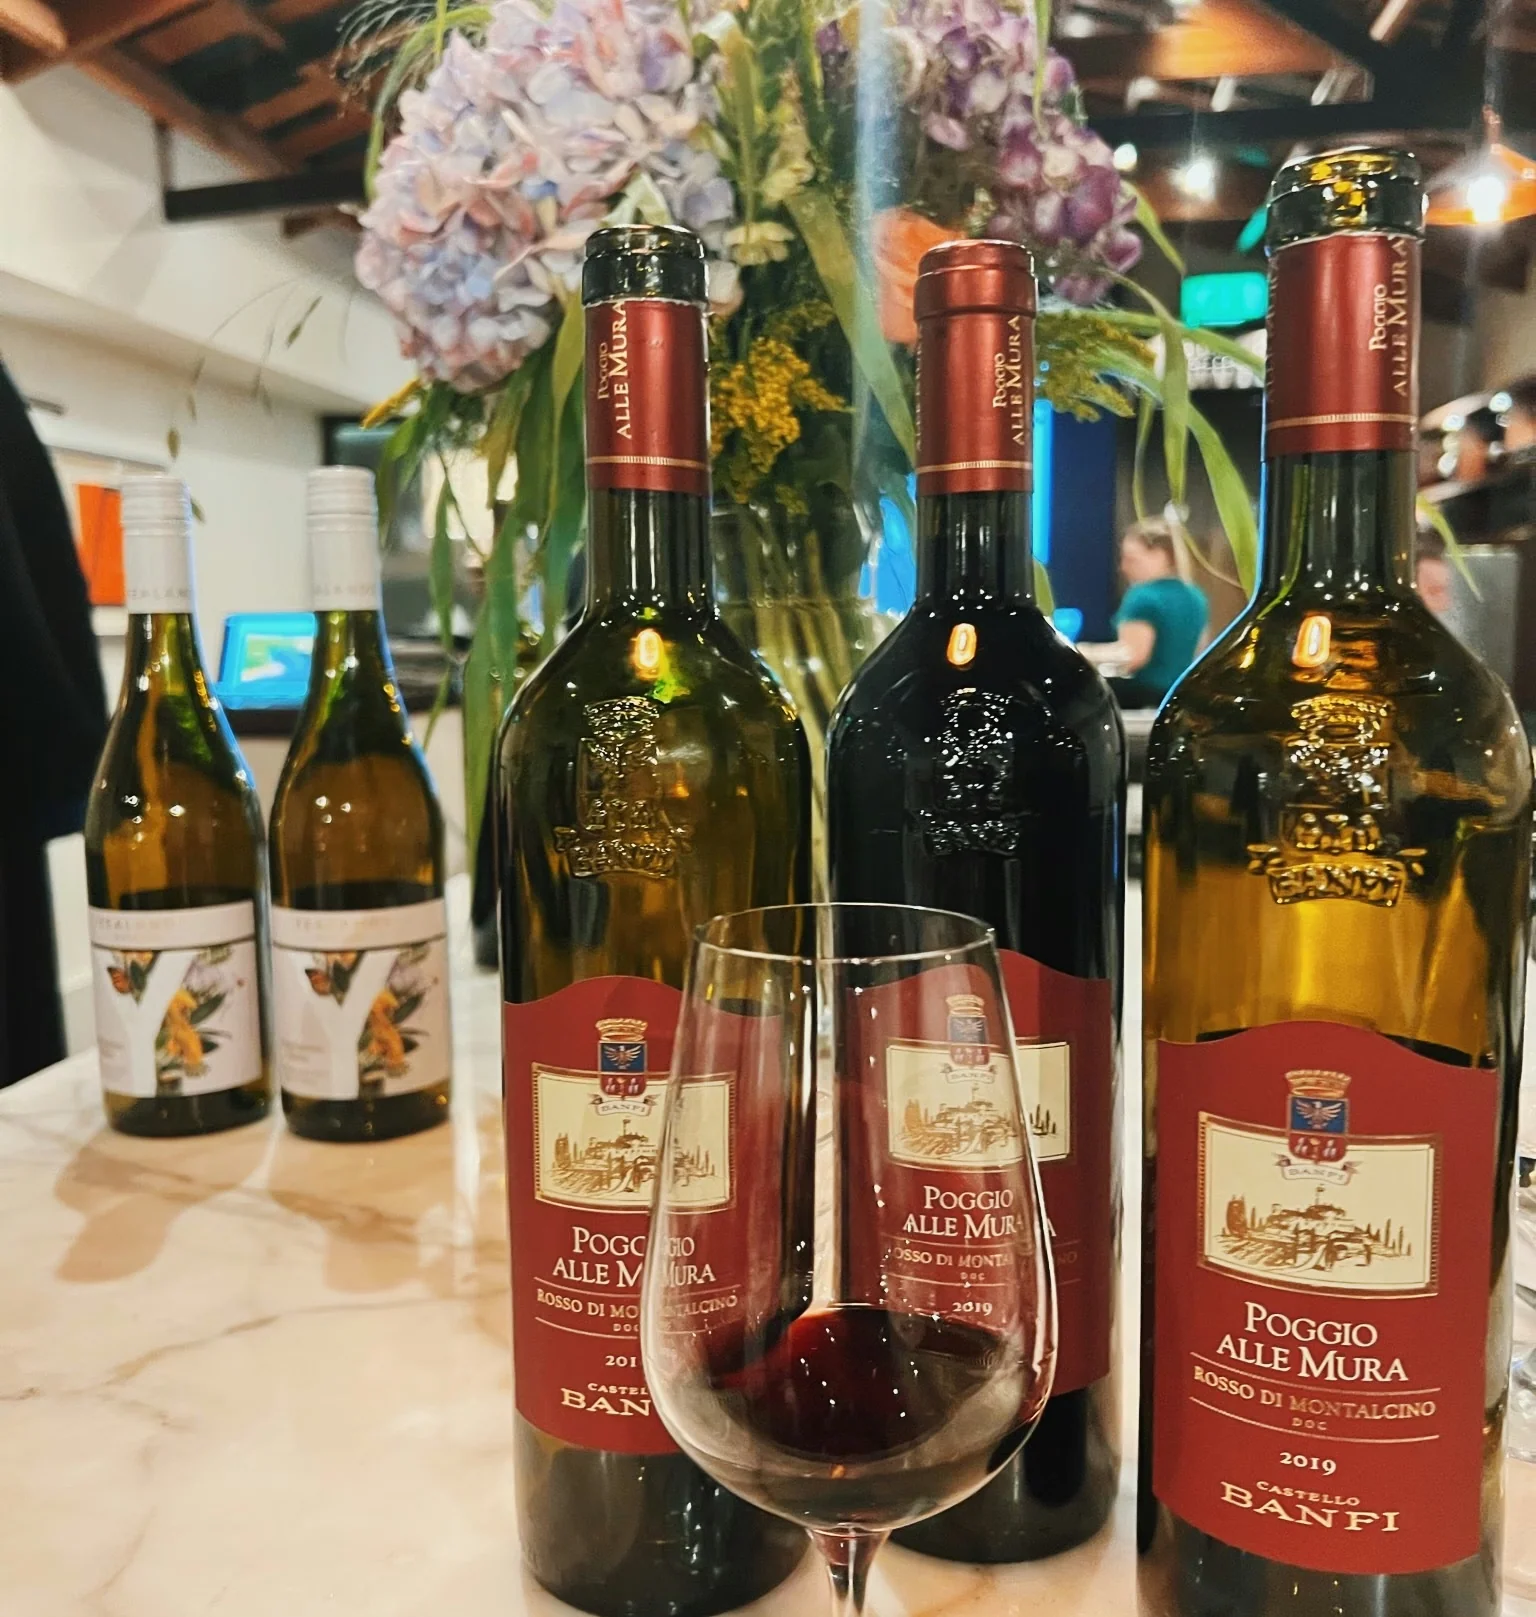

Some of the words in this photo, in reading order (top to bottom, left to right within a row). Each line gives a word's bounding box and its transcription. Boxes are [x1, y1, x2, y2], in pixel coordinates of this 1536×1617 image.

[1388, 239, 1408, 331] MURA
[608, 300, 629, 377] MURA
[1006, 314, 1022, 389] MURA
[1392, 334, 1408, 397] ALLE
[614, 382, 632, 440] ALLE
[1010, 394, 1025, 446] ALLE
[923, 1185, 1014, 1210] POGGIO
[902, 1213, 958, 1237] ALLE
[892, 1247, 932, 1264] OSSO
[936, 1254, 953, 1266] DI
[552, 1257, 610, 1285] ALLE
[616, 1260, 717, 1288] MURA
[536, 1288, 583, 1313] ROSSO
[587, 1301, 605, 1317] DI
[952, 1302, 993, 1317] 2019
[1244, 1301, 1378, 1347] POGGIO
[605, 1355, 637, 1368] 201
[1216, 1334, 1291, 1372] ALLE
[1297, 1346, 1409, 1382] MURA
[561, 1388, 651, 1417] BAN
[588, 1382, 648, 1395] CASTEL
[1193, 1365, 1255, 1399] ROSSO
[1260, 1389, 1283, 1408] DI
[1289, 1395, 1437, 1420] MONTALCINO
[1292, 1417, 1328, 1431] DOC
[1279, 1452, 1337, 1476] 2019
[1220, 1481, 1400, 1532] BANFI
[1256, 1480, 1361, 1507] CASTELLO
